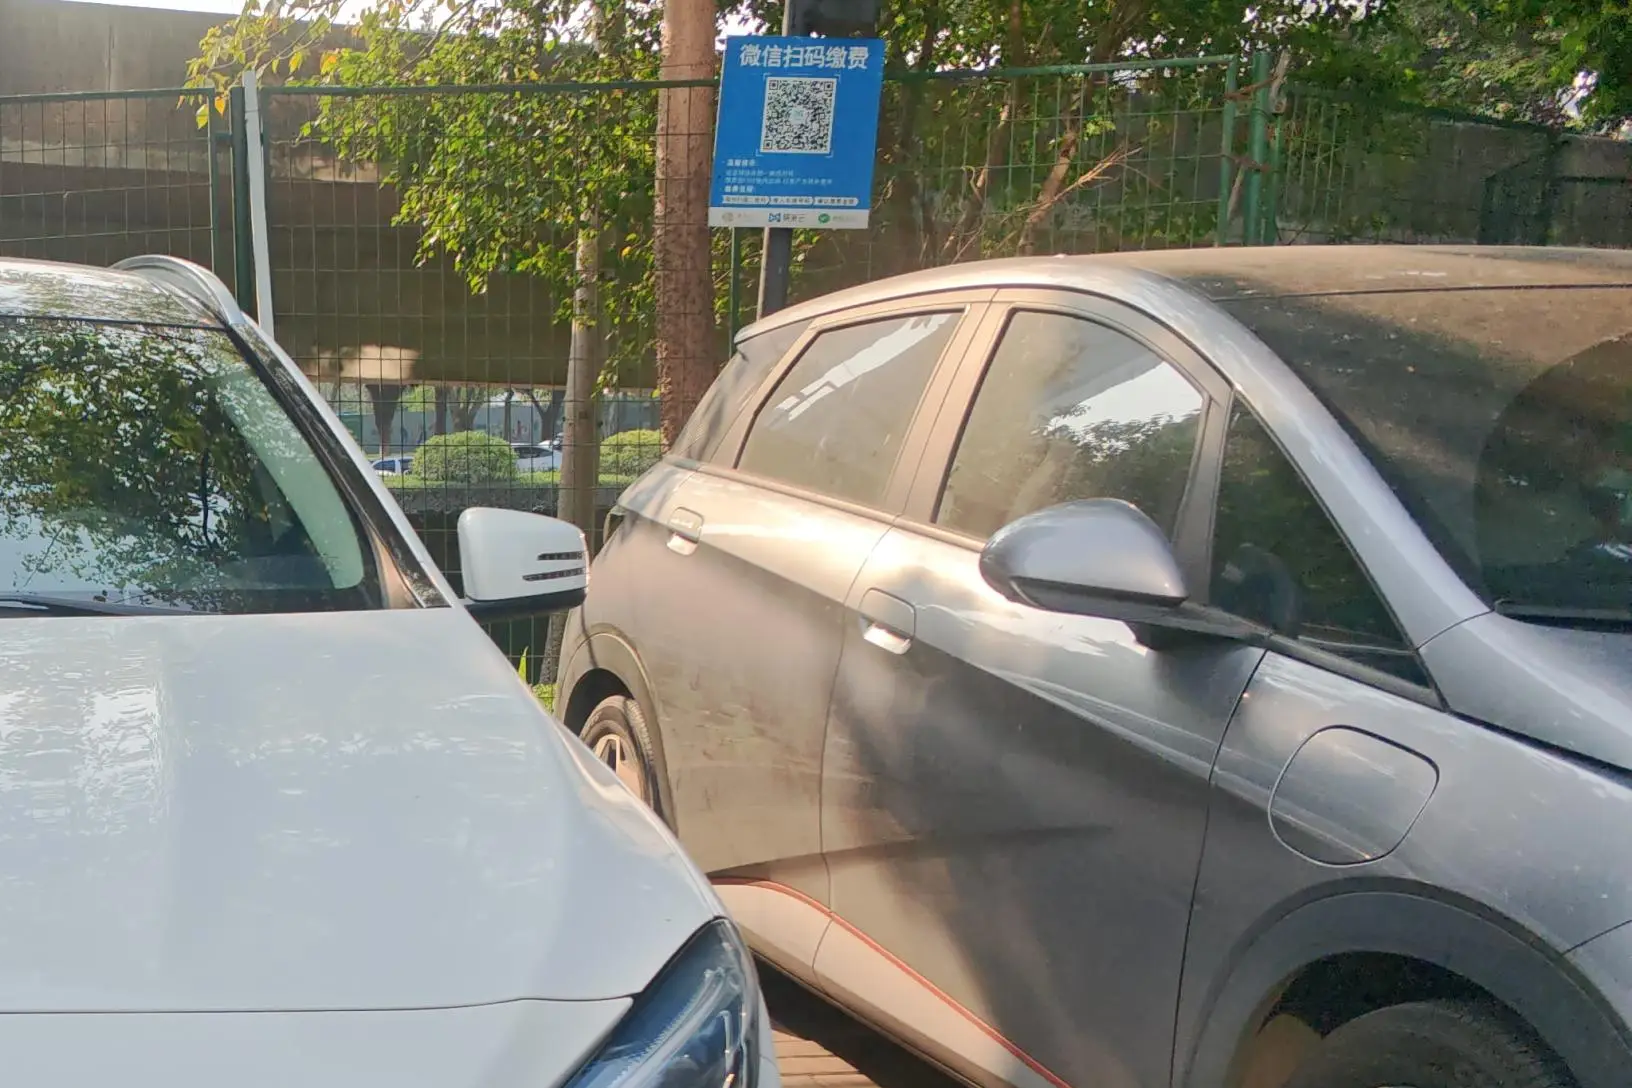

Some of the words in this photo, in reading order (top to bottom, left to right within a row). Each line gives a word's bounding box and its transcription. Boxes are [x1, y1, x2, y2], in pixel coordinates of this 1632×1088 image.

[740, 45, 869, 69] 微信扫码缴费
